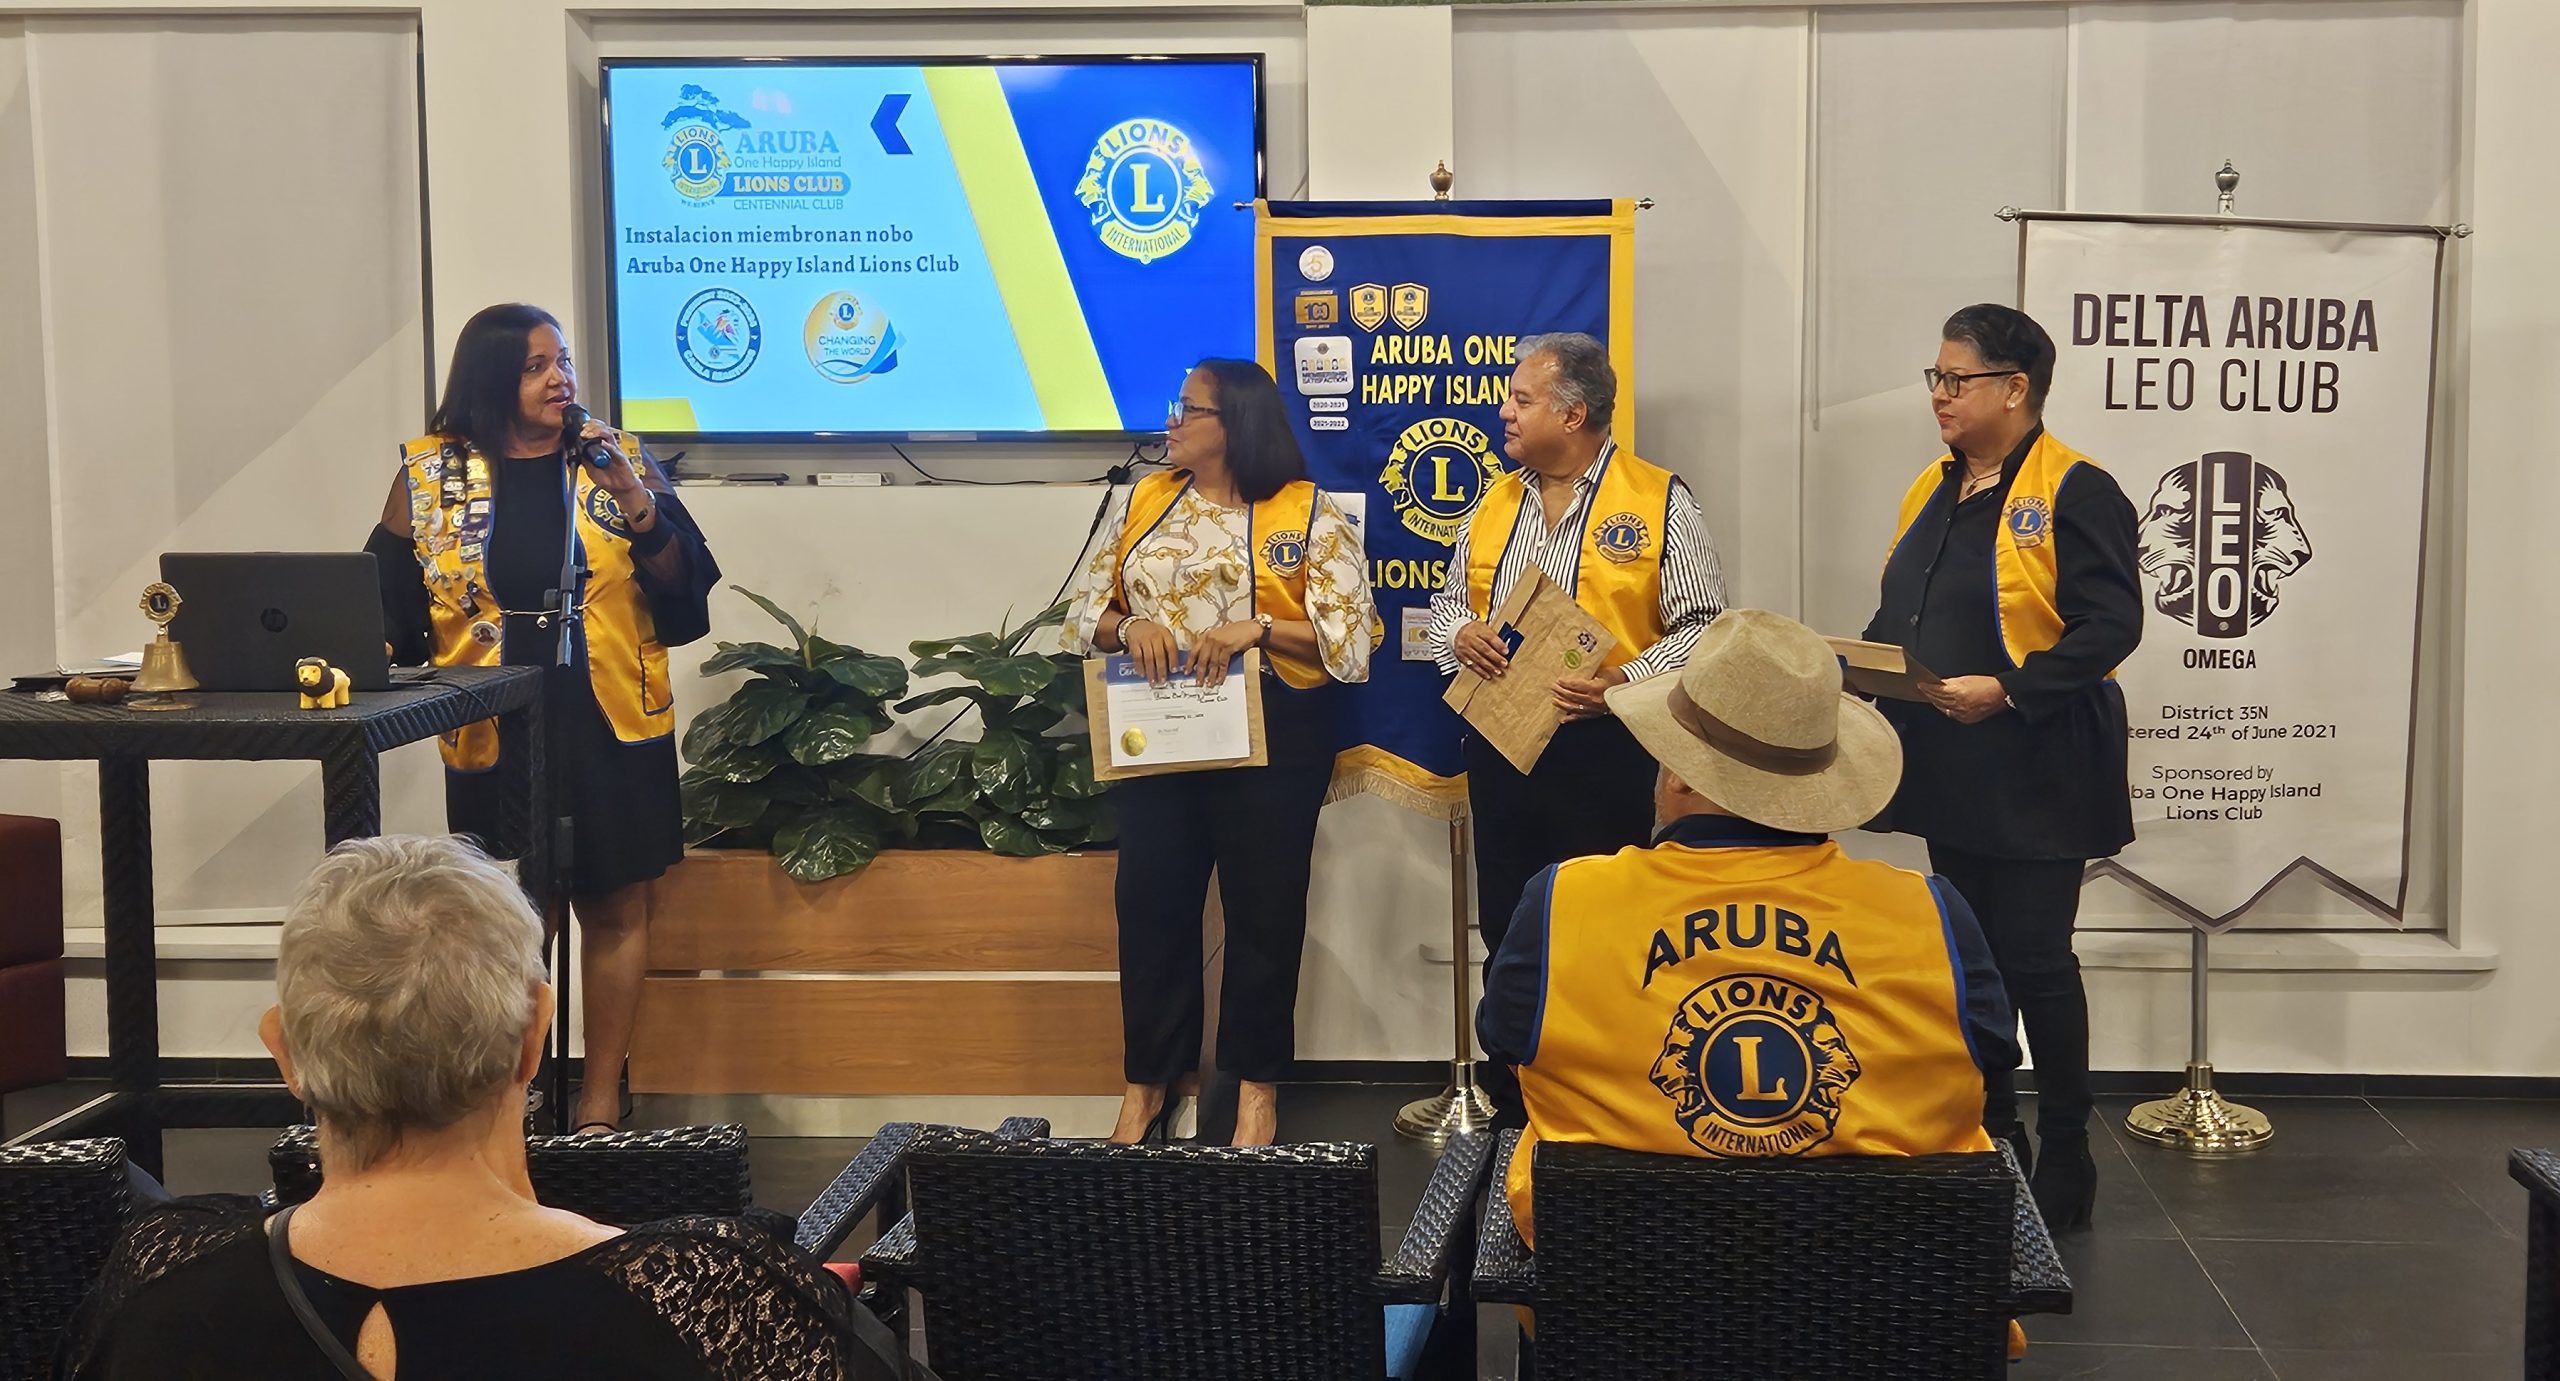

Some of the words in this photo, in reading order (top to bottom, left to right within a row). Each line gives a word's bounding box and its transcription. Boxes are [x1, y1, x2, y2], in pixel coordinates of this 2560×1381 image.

[675, 128, 717, 144] LIONS
[735, 131, 840, 154] ARUBA
[1105, 124, 1184, 152] LIONS
[689, 148, 708, 174] L
[734, 156, 759, 168] One
[763, 156, 804, 170] Happy
[808, 156, 842, 168] Island
[733, 175, 790, 192] LIONS
[794, 175, 844, 192] CLUB
[1129, 163, 1166, 212] L
[733, 199, 809, 210] CENTENNIAL
[813, 199, 844, 210] CLUB
[625, 226, 732, 244] Instalacion
[737, 225, 862, 243] miembronan
[866, 225, 914, 243] nobo
[1106, 227, 1186, 253] INTERNATIONAL
[626, 256, 685, 274] Aruba
[690, 257, 726, 274] One
[731, 256, 793, 279] Happy
[796, 255, 855, 273] Island
[859, 255, 912, 273] Lions
[916, 254, 960, 273] Club
[2072, 293, 2211, 348] DELTA
[2225, 296, 2379, 352] ARUBA
[818, 335, 876, 346] CHANGING
[824, 347, 839, 356] THE
[841, 347, 871, 356] WORLD
[1370, 334, 1454, 365] ARUBA
[1464, 334, 1516, 366] ONE
[1361, 374, 1436, 405] HAPPY
[1446, 375, 1511, 405] ISLAN
[2105, 357, 2195, 411] LEO
[2219, 358, 2339, 413] CLUB
[1411, 420, 1483, 448] LIONS
[1431, 456, 1465, 501] L
[1407, 512, 1458, 538] INTERNATI
[1609, 514, 1643, 527] LIONS
[2018, 512, 2033, 530] L
[1271, 532, 1301, 543] LIONS
[1615, 529, 1630, 546] L
[2207, 463, 2242, 618] LEO
[1282, 545, 1298, 563] L
[2183, 648, 2257, 669] OMEGA
[2162, 704, 2234, 720] District
[2239, 705, 2269, 720] 35N
[2128, 725, 2180, 740] tered
[2187, 725, 2225, 740] 24th
[2231, 724, 2250, 741] of
[2252, 725, 2287, 740] June
[2292, 724, 2337, 739] 2021
[2151, 765, 2253, 783] Sponsored
[2257, 765, 2274, 782] by
[2130, 785, 2155, 799] ba
[2162, 785, 2204, 800] One
[2211, 785, 2267, 804] Happy
[2270, 783, 2322, 798] Island
[2166, 806, 2219, 821] Lions
[2224, 805, 2263, 820] Club
[1642, 904, 1859, 990] ARUBA
[1691, 981, 1815, 1024] LIONS
[1732, 1036, 1788, 1101] L
[1701, 1121, 1822, 1154] INTERNATIONAL
